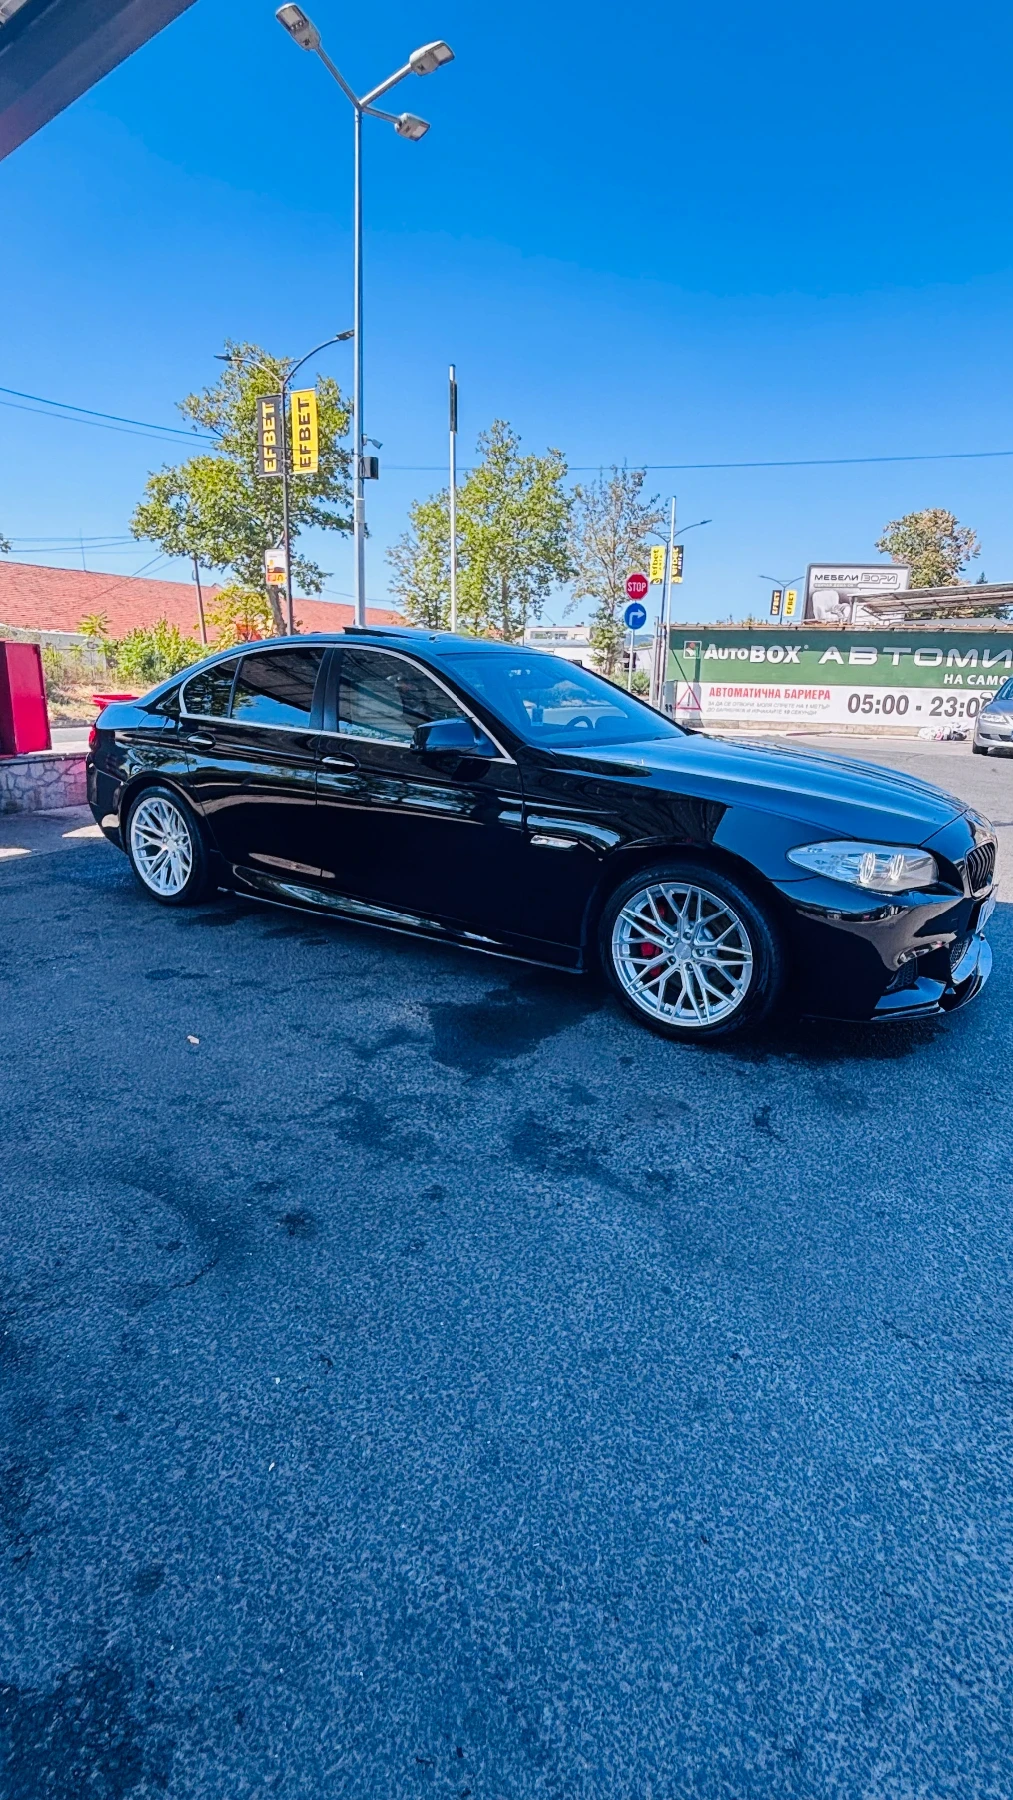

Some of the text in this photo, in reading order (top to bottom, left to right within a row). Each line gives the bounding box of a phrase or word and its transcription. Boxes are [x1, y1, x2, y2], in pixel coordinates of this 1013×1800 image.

[262, 401, 277, 473] EFBET
[298, 397, 312, 468] EFBET
[652, 549, 660, 576] efbet
[627, 582, 647, 592] STOP
[863, 574, 896, 582] ЗОРИ
[818, 646, 1013, 669] АВТОМИ
[943, 674, 1010, 686] НА САМО
[709, 687, 831, 700] АВТОМАТИЧНА БАРИЕРА
[847, 693, 910, 716] 05:00
[929, 696, 993, 718] 23:0
